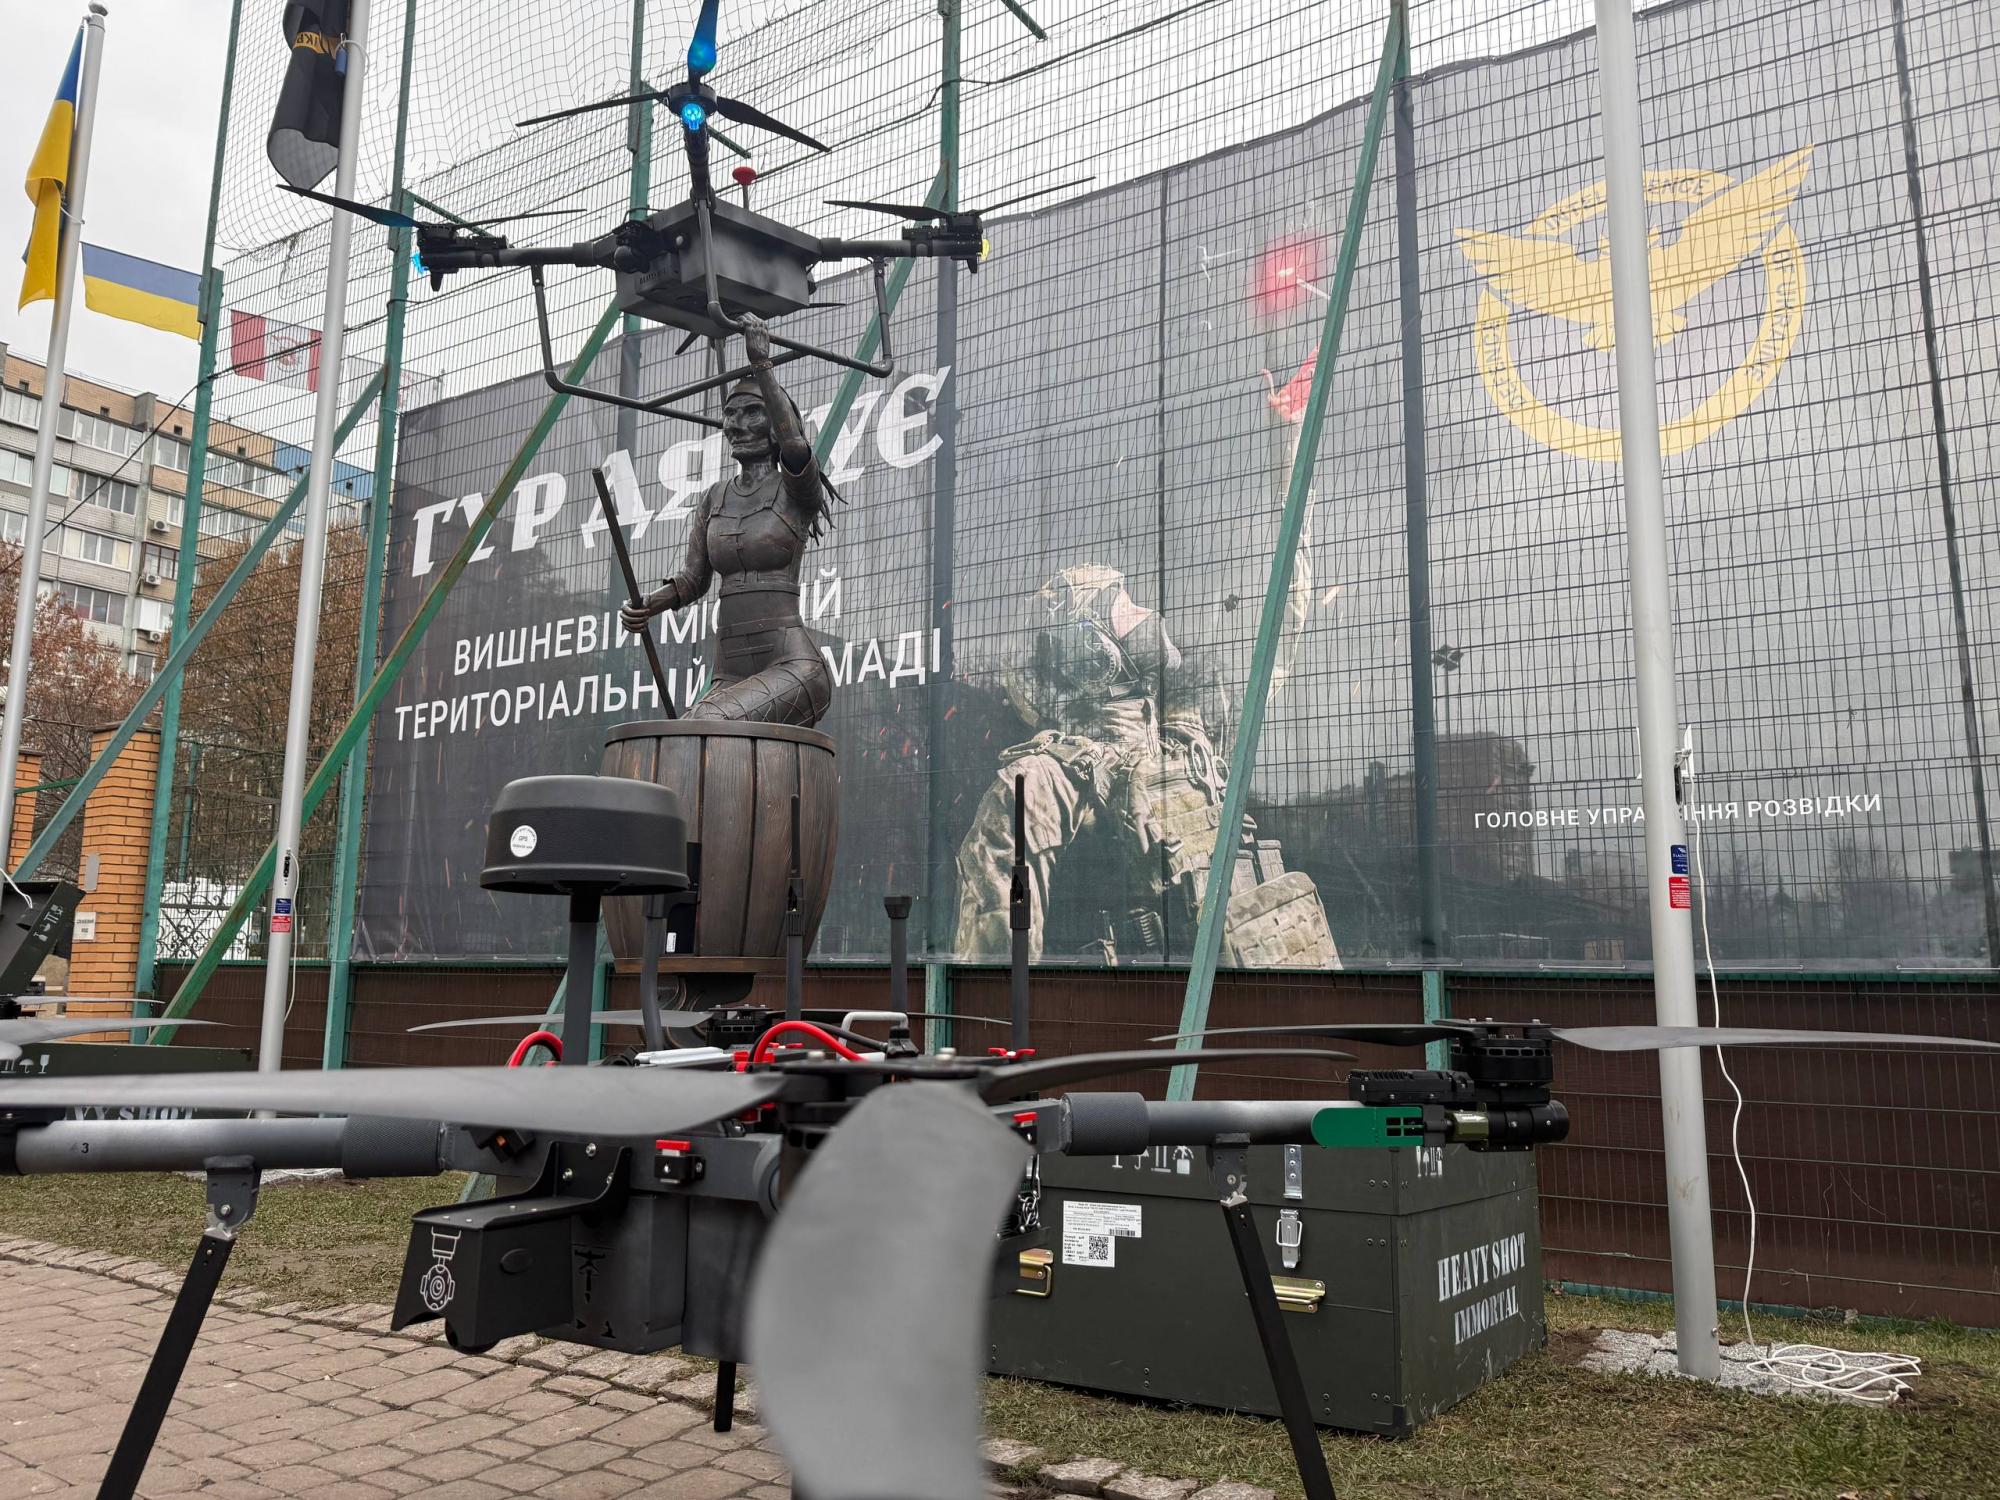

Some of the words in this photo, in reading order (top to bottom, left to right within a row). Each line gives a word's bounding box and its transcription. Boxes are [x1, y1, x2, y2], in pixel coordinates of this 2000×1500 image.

[412, 472, 567, 577] ГУР
[581, 365, 951, 549] ДЯУЄ
[660, 568, 842, 644] МІІЙ
[395, 656, 706, 741] ТЕРИТОРІАЛЬНІЙ
[1474, 809, 1579, 828] ГОЛОВНЕ
[1587, 802, 1738, 825] УПРАІННЯ
[1748, 793, 1881, 818] РОЗВІДКИ
[1437, 1244, 1490, 1302] HEAVY
[1491, 1232, 1526, 1279] SHOT
[1454, 1285, 1519, 1345] IMMORTAL
